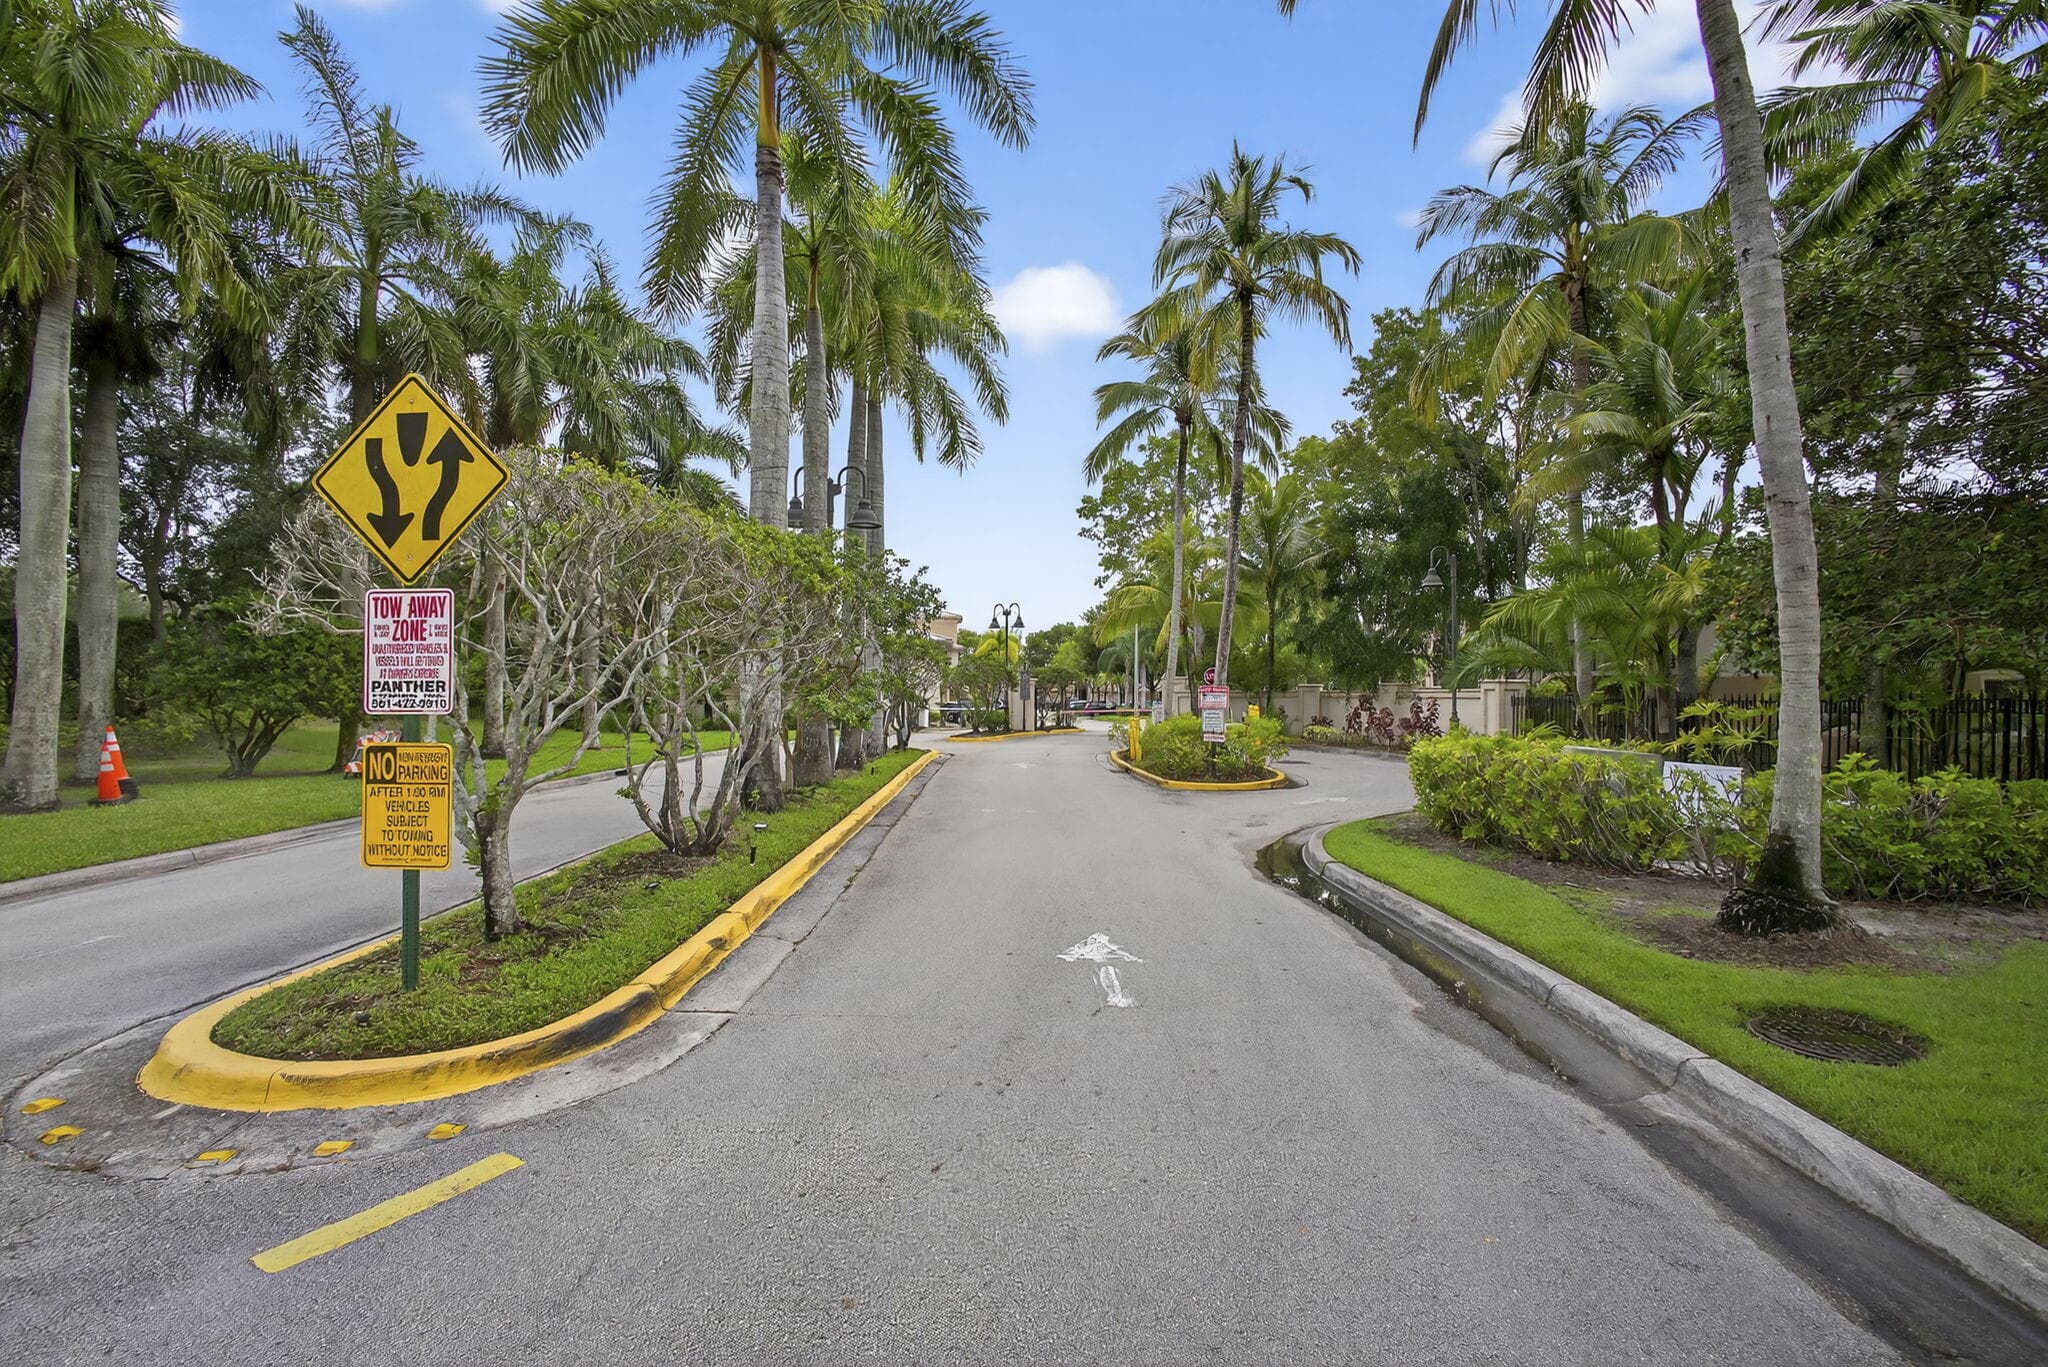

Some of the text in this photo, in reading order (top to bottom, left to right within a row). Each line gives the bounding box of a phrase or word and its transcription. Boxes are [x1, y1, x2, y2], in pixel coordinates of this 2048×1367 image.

[372, 596, 448, 619] TOW AWAY
[392, 619, 427, 641] ZONE
[371, 680, 446, 693] PANTHER
[369, 752, 395, 780] NO
[398, 765, 448, 781] PARKING
[369, 786, 403, 798] AFTER
[385, 800, 430, 813] VEHICLES
[386, 815, 429, 827] SUBJECT
[381, 829, 433, 842] TO TOWING
[368, 844, 447, 857] WITHOUT NOTICE
